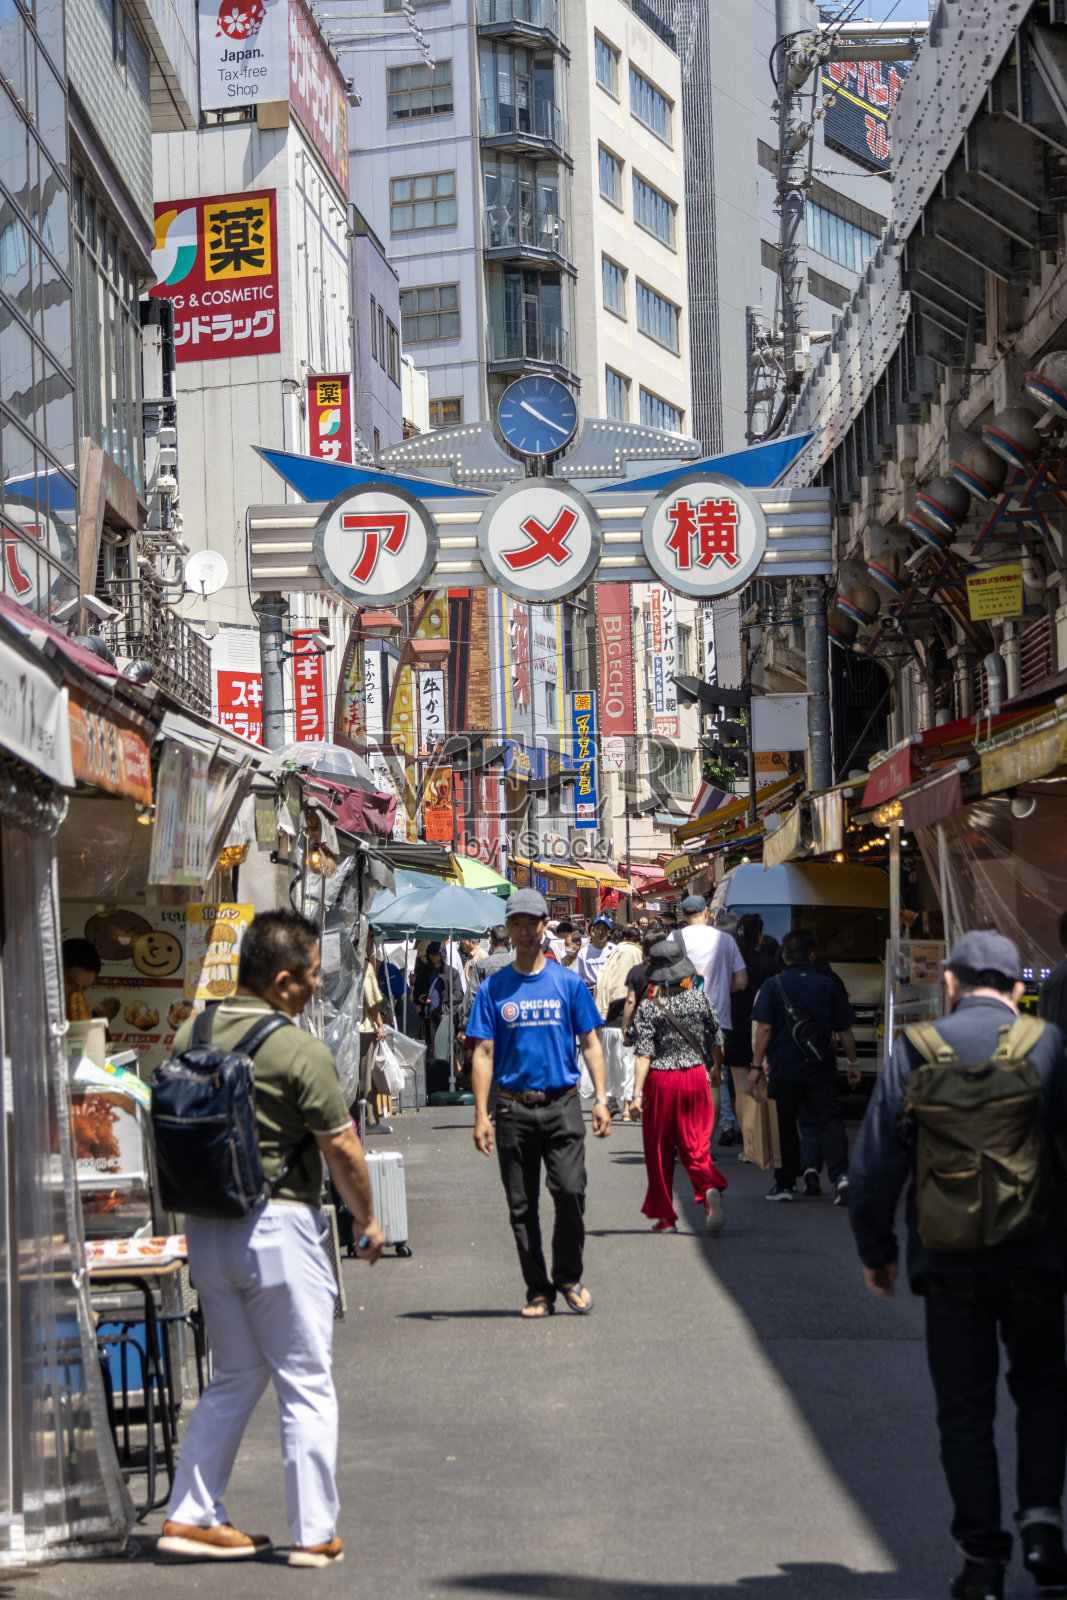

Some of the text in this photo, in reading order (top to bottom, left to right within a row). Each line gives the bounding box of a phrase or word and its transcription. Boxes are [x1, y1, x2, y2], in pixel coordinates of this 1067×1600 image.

[220, 48, 265, 64] Japan.
[217, 66, 268, 82] Tax-free
[227, 83, 259, 98] Shop
[209, 206, 265, 275] 薬
[189, 294, 199, 307] &
[201, 285, 274, 306] COSMETIC
[318, 382, 340, 404] 薬
[319, 440, 342, 461] サ
[341, 497, 742, 586] アメ横
[602, 615, 622, 656] BIG
[605, 659, 625, 718] ECHO
[575, 713, 591, 796] マツモトキヨシ
[520, 999, 561, 1010] CHICAGO
